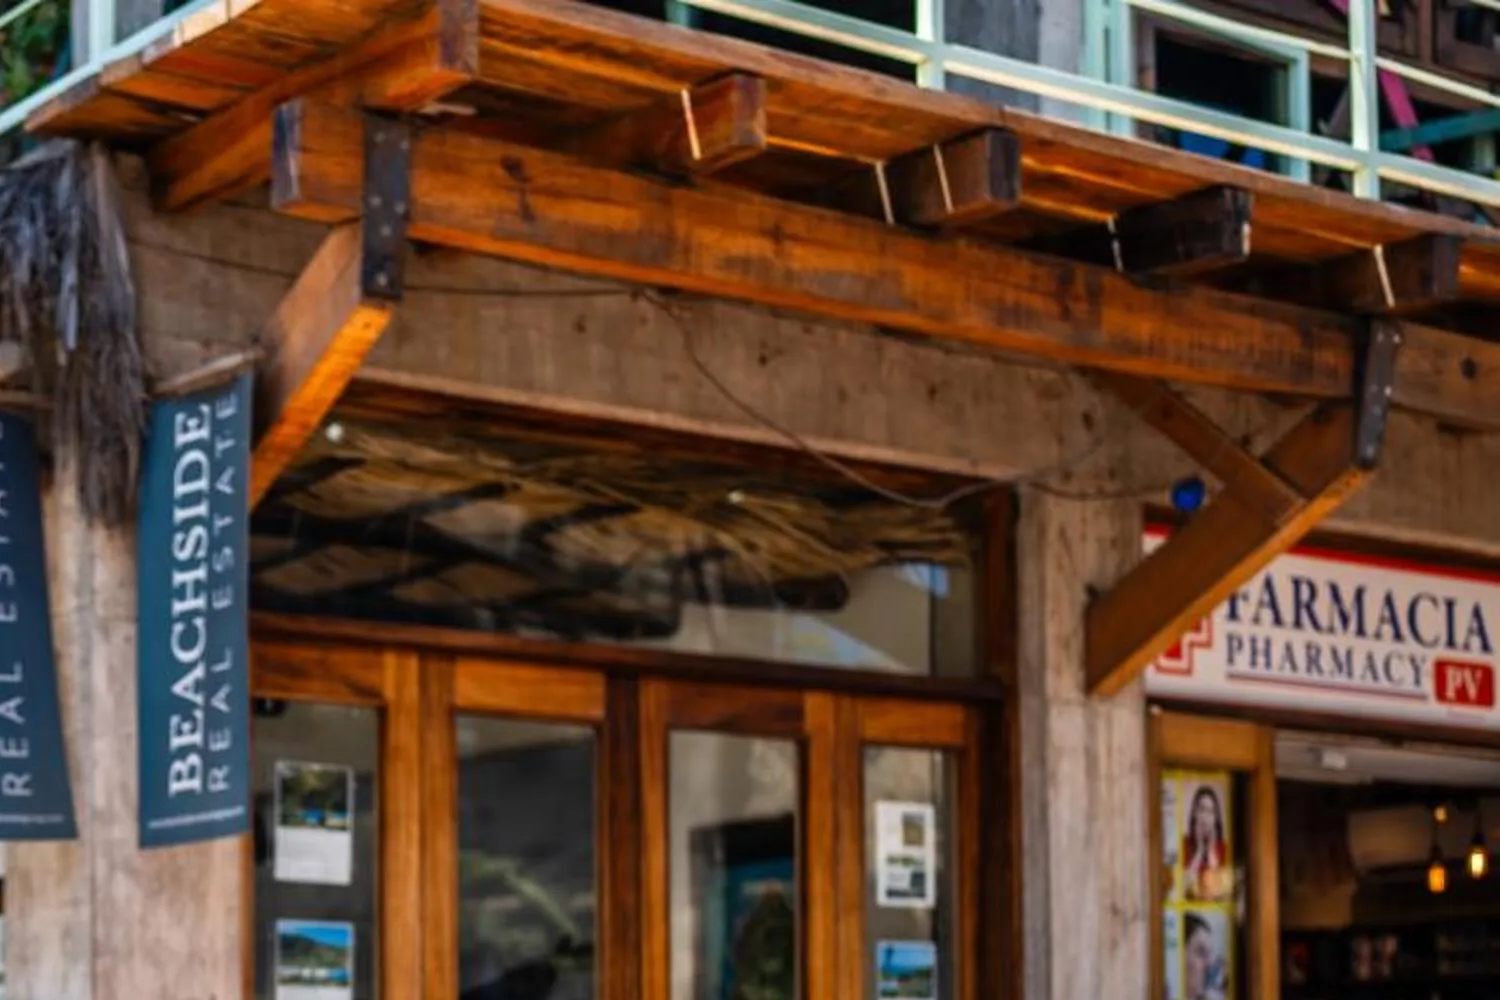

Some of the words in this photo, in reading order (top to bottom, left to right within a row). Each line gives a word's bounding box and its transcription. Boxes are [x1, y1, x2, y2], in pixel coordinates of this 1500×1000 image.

[211, 392, 240, 610] ESTATE
[169, 403, 212, 798] BEACHSIDE
[1226, 632, 1428, 688] PHARMACY
[1445, 665, 1483, 702] PV
[208, 648, 234, 793] REAL
